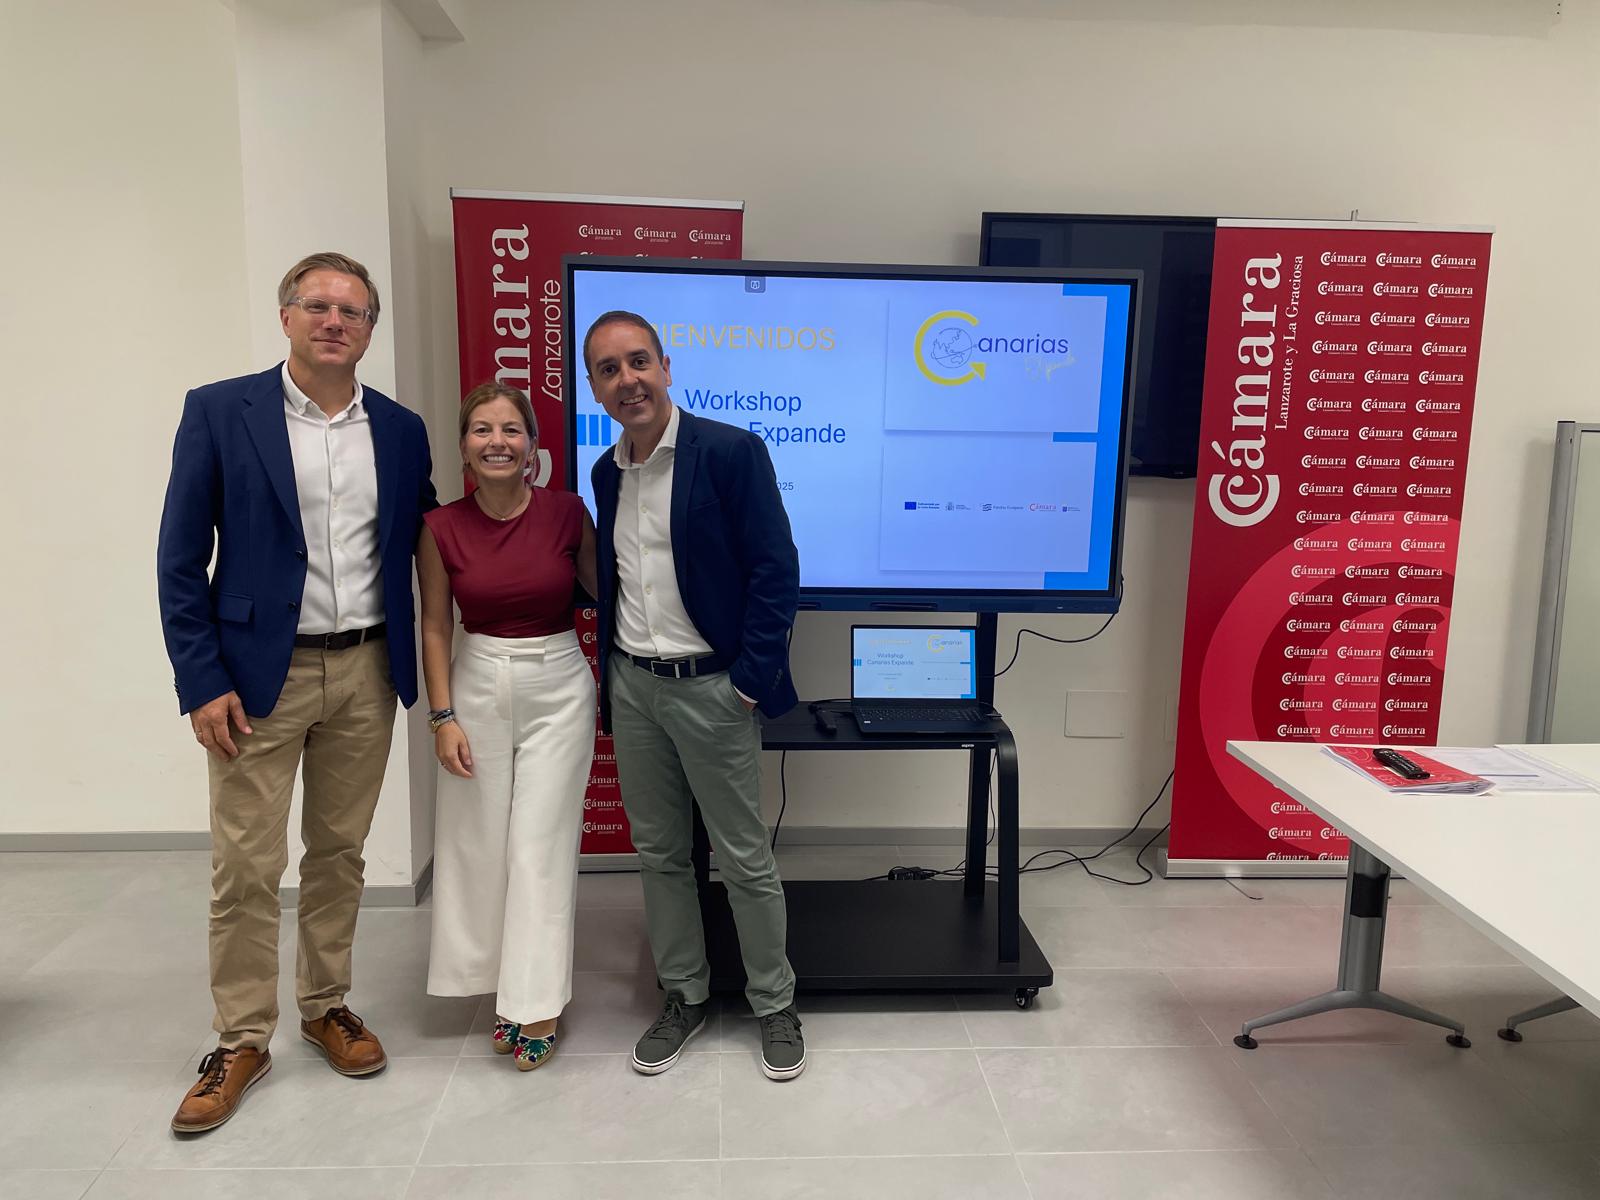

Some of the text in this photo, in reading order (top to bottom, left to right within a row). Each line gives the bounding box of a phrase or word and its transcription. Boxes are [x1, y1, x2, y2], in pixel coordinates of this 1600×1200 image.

[540, 279, 564, 402] Lanzarote
[1275, 255, 1304, 430] Lanzarote y La Graciosa
[685, 389, 802, 415] Workshop
[749, 422, 846, 446] Expande
